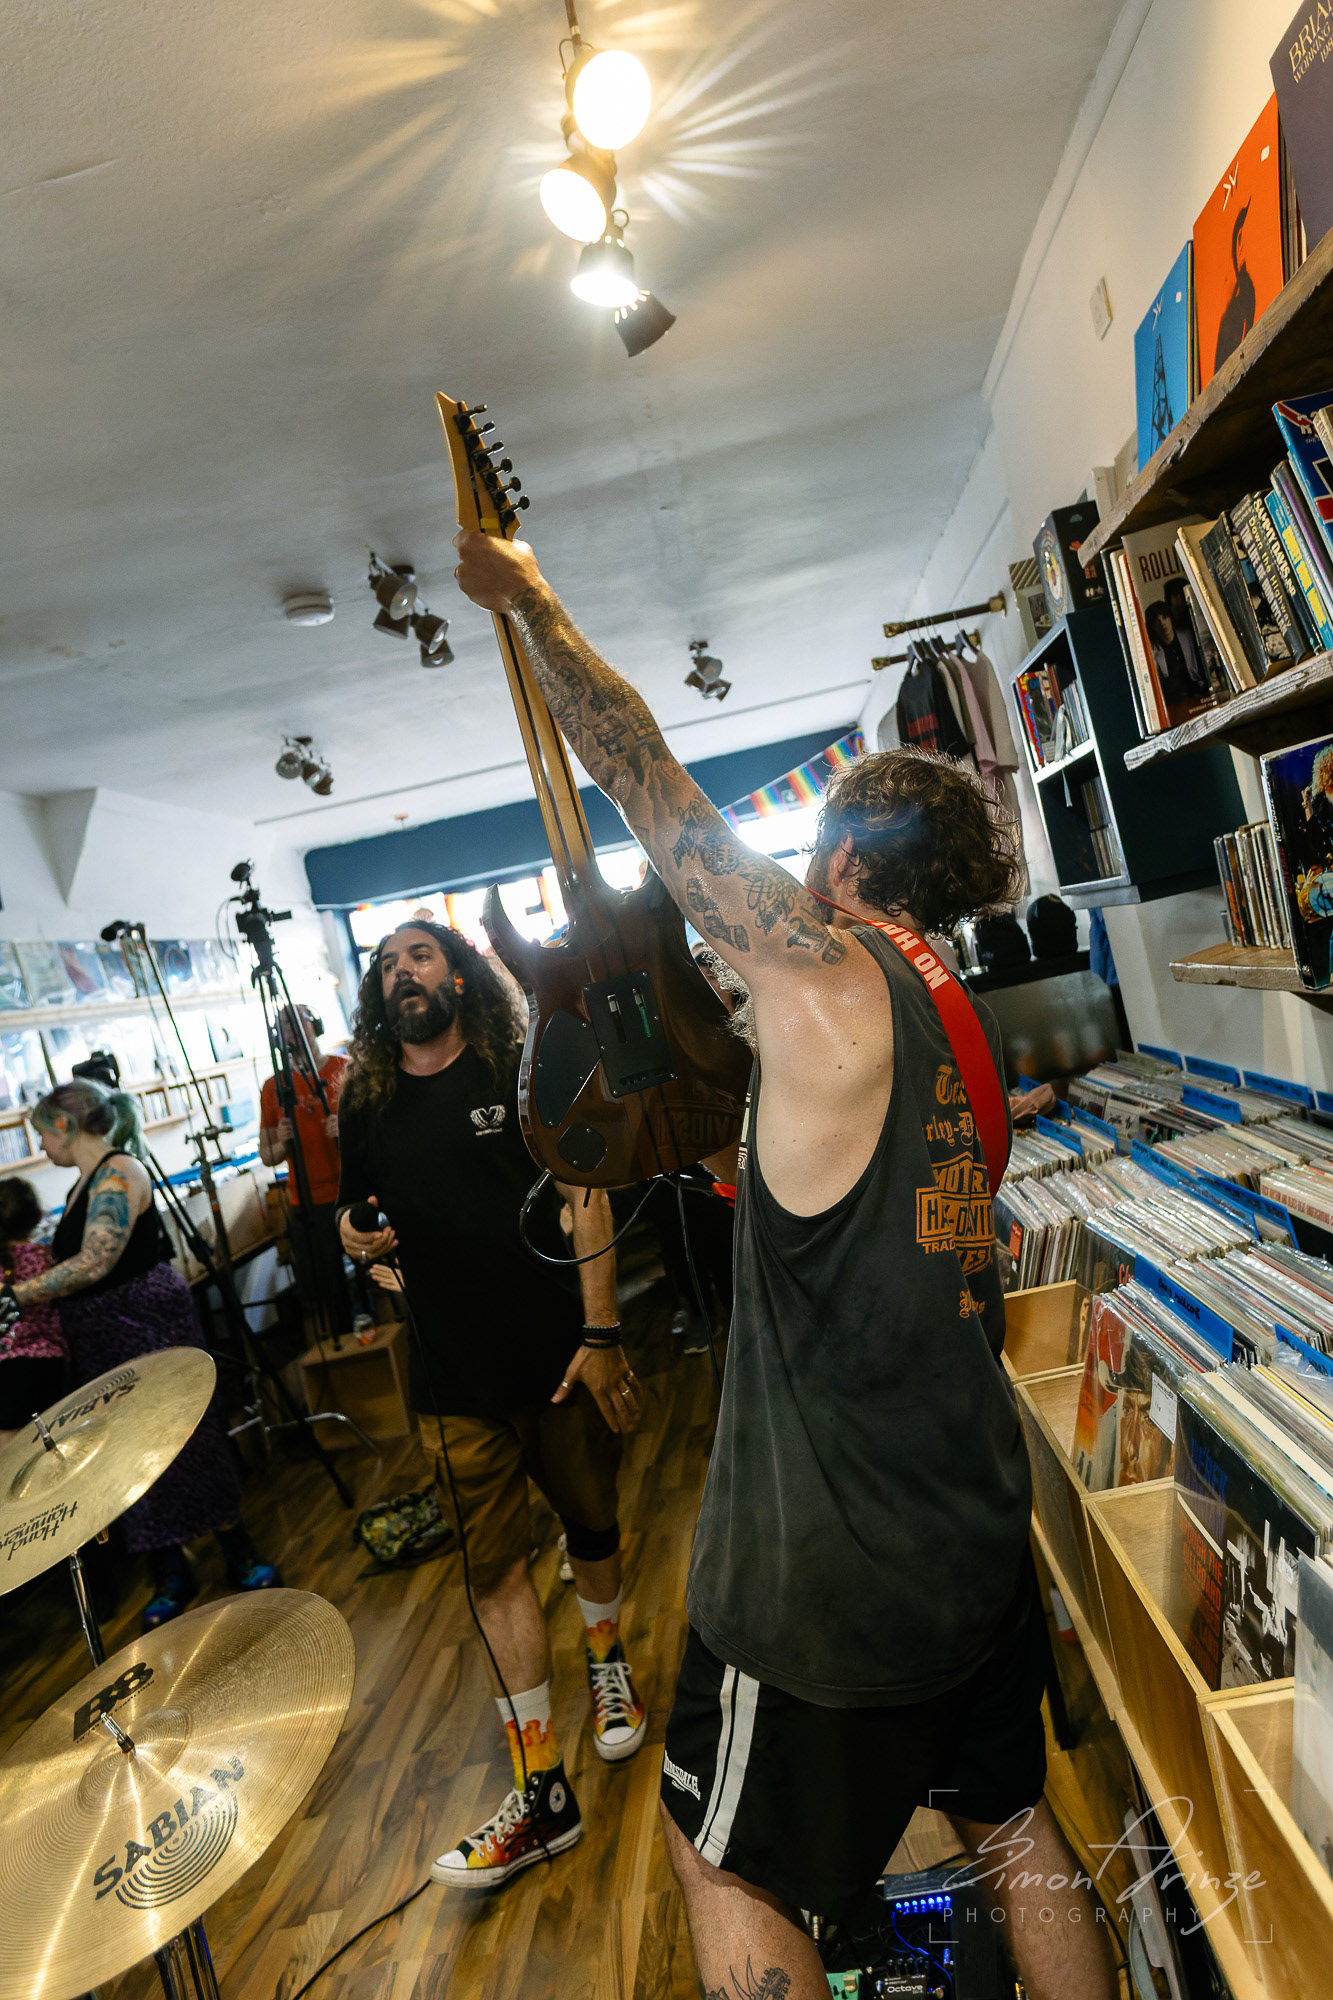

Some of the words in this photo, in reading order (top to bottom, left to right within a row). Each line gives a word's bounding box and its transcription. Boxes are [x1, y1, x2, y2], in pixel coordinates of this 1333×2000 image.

[1289, 0, 1333, 73] BRIA
[1294, 21, 1331, 84] WORKING
[1254, 499, 1277, 546] SAMMY
[1271, 543, 1291, 580] DAVIS
[1138, 546, 1185, 584] ROLLI
[1249, 516, 1263, 550] Down
[1262, 551, 1271, 574] the
[1269, 575, 1292, 627] Highway
[874, 921, 921, 952] HA
[914, 952, 950, 991] NO
[935, 1064, 967, 1105] Tex
[922, 1111, 982, 1147] rley-D
[32, 1376, 141, 1443] SABIAN
[0, 1500, 78, 1549] Hammer
[7, 1523, 60, 1561] Hand
[1208, 1546, 1224, 1587] THE
[73, 1662, 154, 1742] B8
[93, 1755, 245, 1901] SABIAN
[887, 1984, 924, 1993] Octave
